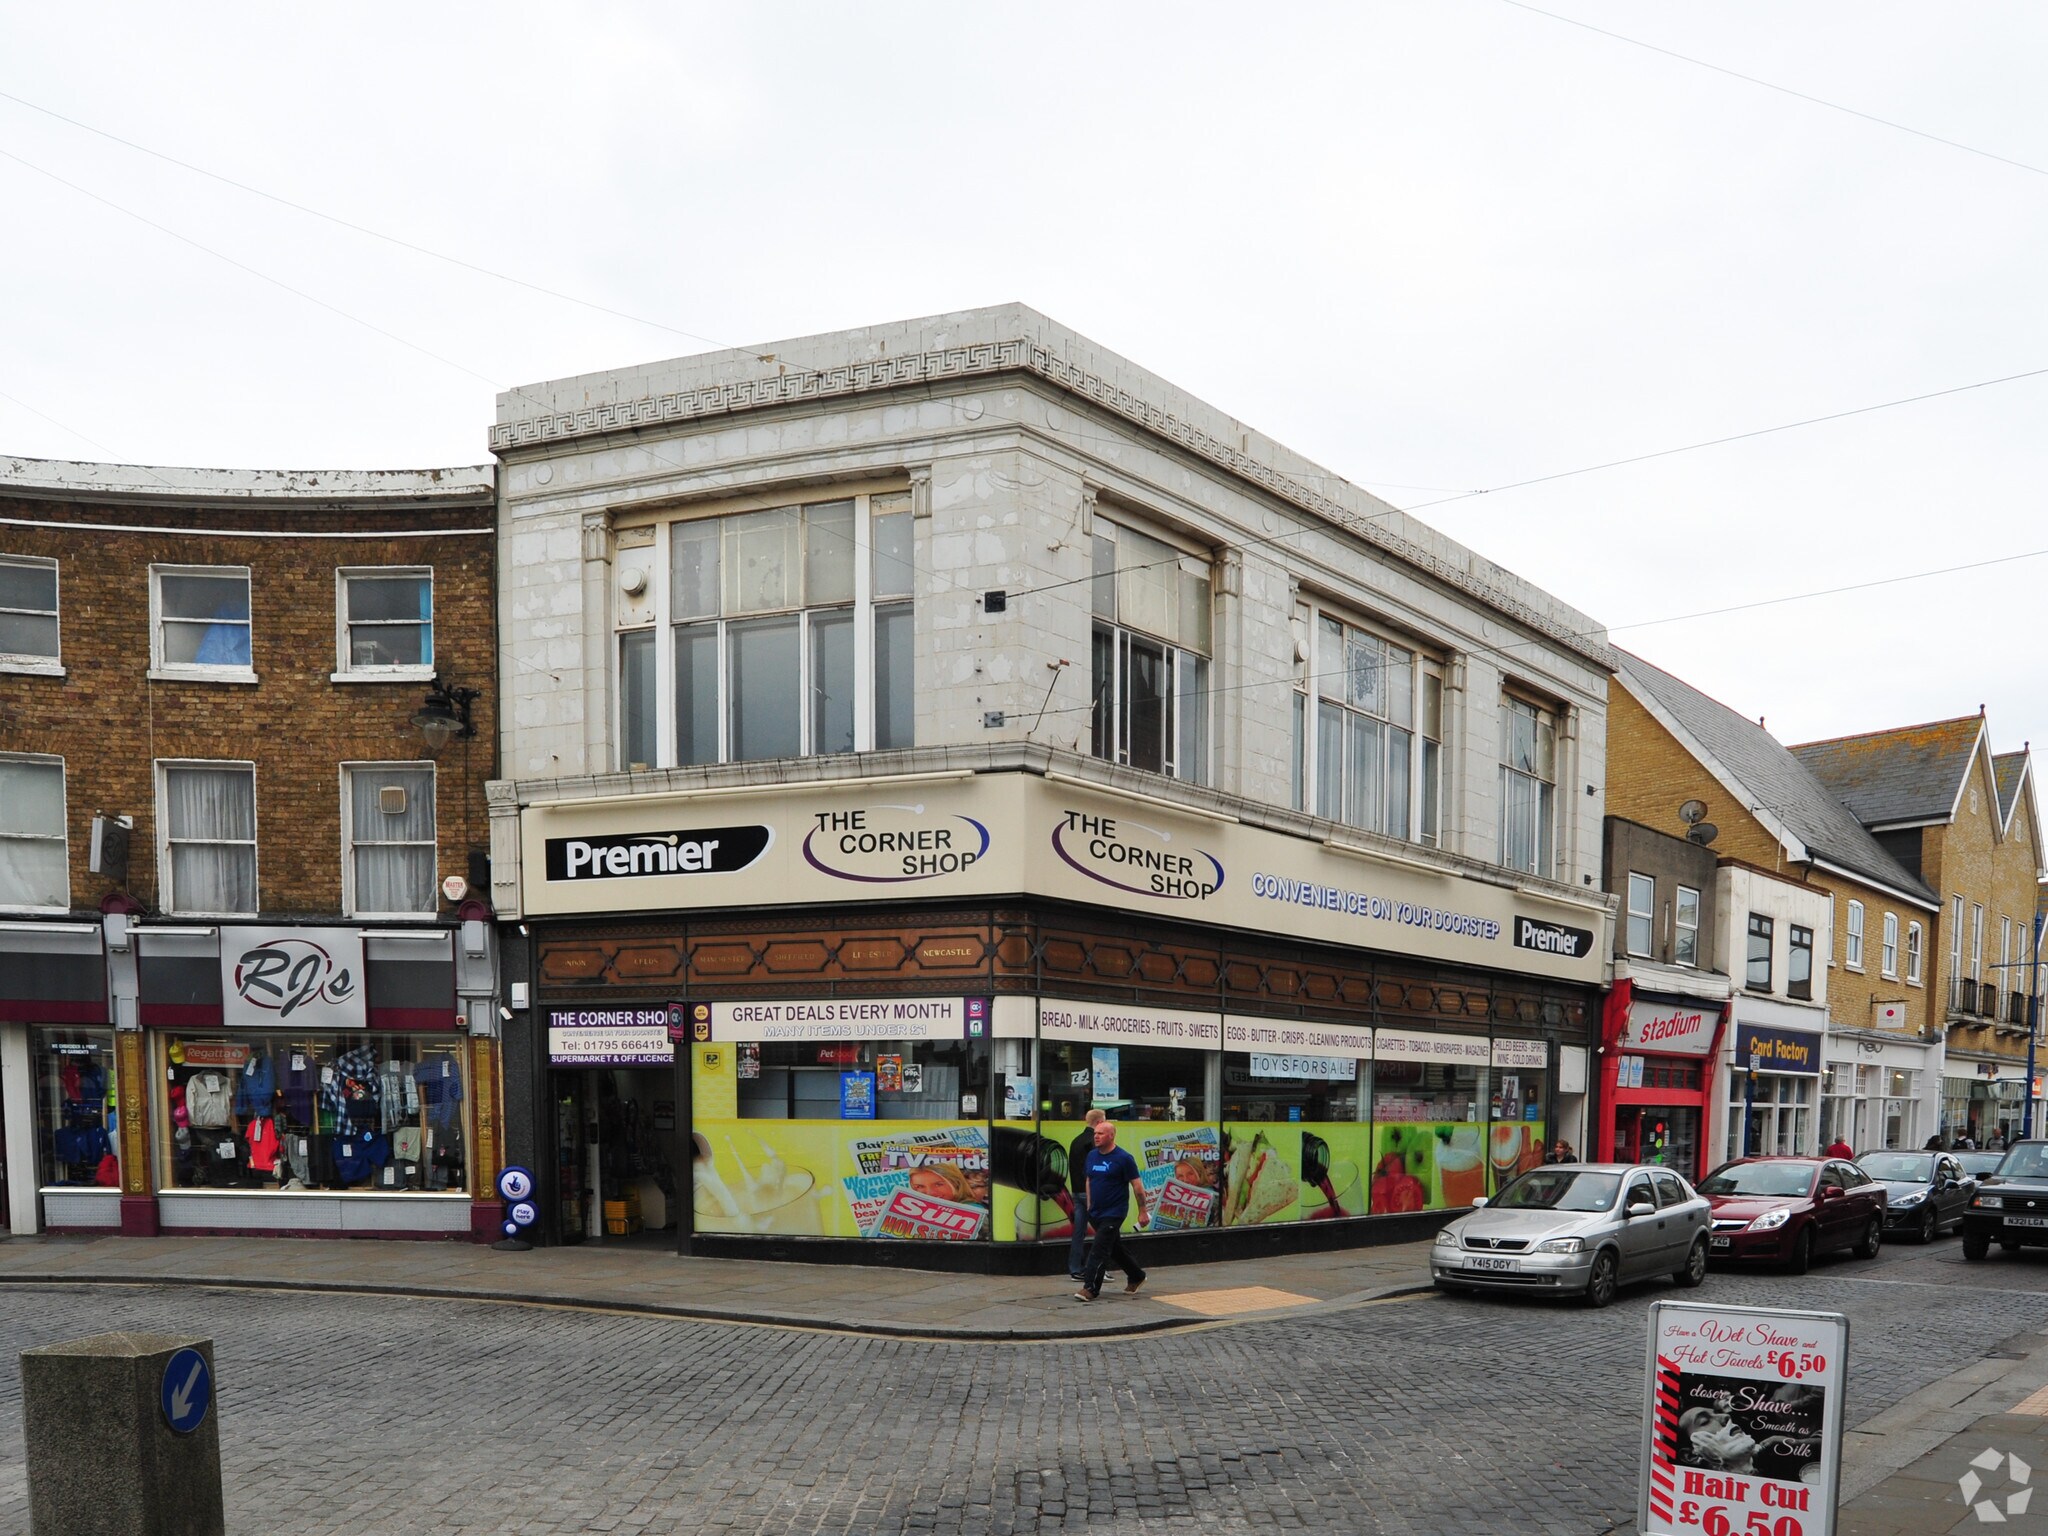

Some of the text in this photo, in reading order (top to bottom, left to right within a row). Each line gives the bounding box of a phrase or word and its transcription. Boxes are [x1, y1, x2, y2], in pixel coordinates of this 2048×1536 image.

[815, 810, 866, 832] THE
[1064, 810, 1116, 839] THE
[839, 829, 952, 853] CORNER
[566, 835, 719, 878] Premier
[901, 851, 976, 875] SHOP
[1089, 839, 1193, 877] CORNER
[1150, 873, 1215, 900] SHOP
[1252, 872, 1500, 941] CONVENIENCE ON YOUR DOORSTEP
[1521, 919, 1578, 955] Premier
[923, 948, 972, 957] NEWCASTLE
[239, 948, 355, 1018] RJ's
[551, 1012, 577, 1026] THE
[579, 1011, 634, 1025] CORNER
[732, 1006, 782, 1022] GREAT
[786, 1005, 835, 1021] DEALS
[840, 1004, 889, 1020] EVERY
[893, 1003, 952, 1019] MONTH
[763, 1024, 927, 1038] MANY ITEMS UNDER £1
[1041, 1011, 1072, 1028] BREAD
[1079, 1014, 1099, 1030] MILK
[1156, 1021, 1183, 1037] FRUITS
[1189, 1024, 1219, 1039] SWEETS
[1640, 1011, 1701, 1043] stadium
[561, 1040, 663, 1051] Tel: 01795 666419
[1227, 1026, 1372, 1050] EGGS BUTTER CRISPS CLEANING PRODUCTS
[1376, 1037, 1489, 1057] CIGARETTES TOBACCO NEWSPAPERS MAGAZINES
[1492, 1041, 1547, 1053] CHILLED BEERS SPIRITS
[188, 1048, 230, 1059] Regatta
[551, 1054, 674, 1063] SUPERMARKET & OFF LICENCE
[820, 1049, 833, 1058] Pet
[1497, 1054, 1542, 1065] WINE COLD DRINKS
[1750, 1036, 1773, 1058] Card
[1776, 1039, 1809, 1065] Factory
[1507, 1102, 1516, 1116] £2
[913, 1133, 947, 1143] Mail
[952, 1127, 977, 1138] FREE
[1177, 1132, 1195, 1141] Mail
[859, 1153, 881, 1162] FRE
[843, 1172, 909, 1190] Woman's
[851, 1202, 872, 1210] The
[1166, 1185, 1209, 1209] Sun
[894, 1197, 976, 1230] Sun
[881, 1215, 929, 1239] HOLS
[1472, 1258, 1491, 1269] Y415
[1664, 1325, 1690, 1337] Have
[1699, 1320, 1745, 1343] Wet
[1746, 1323, 1798, 1347] Shave
[1802, 1340, 1818, 1349] and
[1664, 1344, 1826, 1380] Hot Towels £6.50
[1689, 1383, 1728, 1400] closer
[1750, 1415, 1810, 1436] Smooth as
[1774, 1438, 1812, 1459] Silk
[1683, 1470, 1811, 1512] Hair Cut
[1678, 1500, 1803, 1536] £6.50
